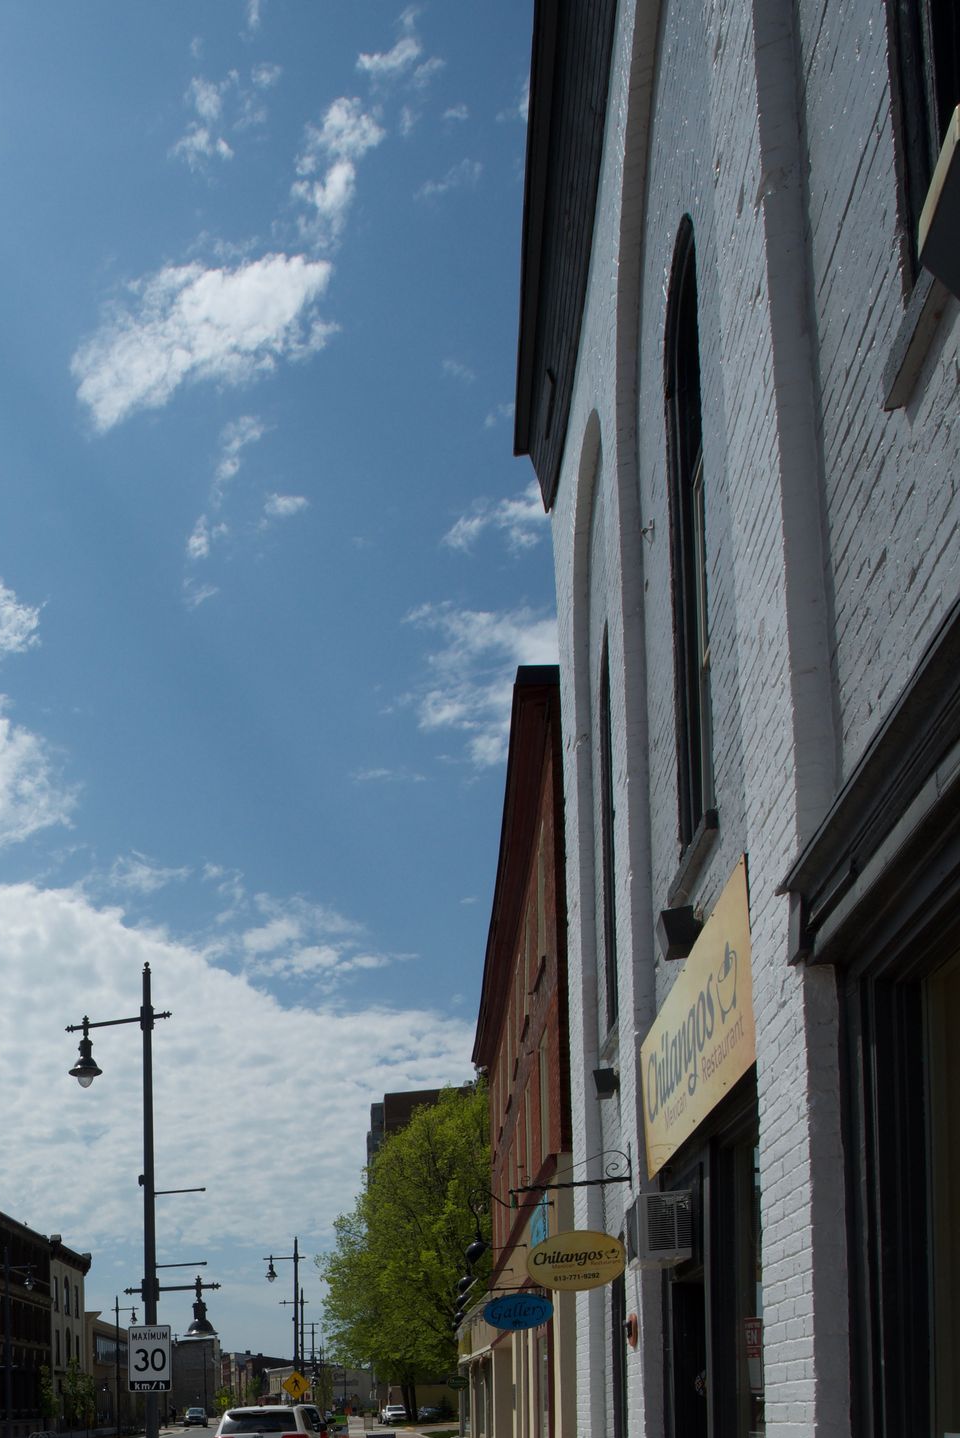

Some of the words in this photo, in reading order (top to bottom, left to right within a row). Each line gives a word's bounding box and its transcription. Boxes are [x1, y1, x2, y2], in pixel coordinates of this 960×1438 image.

[647, 973, 715, 1125] Chilangos
[663, 1091, 688, 1131] Mexican
[701, 1012, 745, 1082] Restaurant
[533, 1249, 604, 1266] Chilangos
[490, 1302, 547, 1323] Gallery
[131, 1331, 168, 1341] MAXIMUM
[134, 1348, 166, 1372] 30
[134, 1381, 166, 1390] km/h
